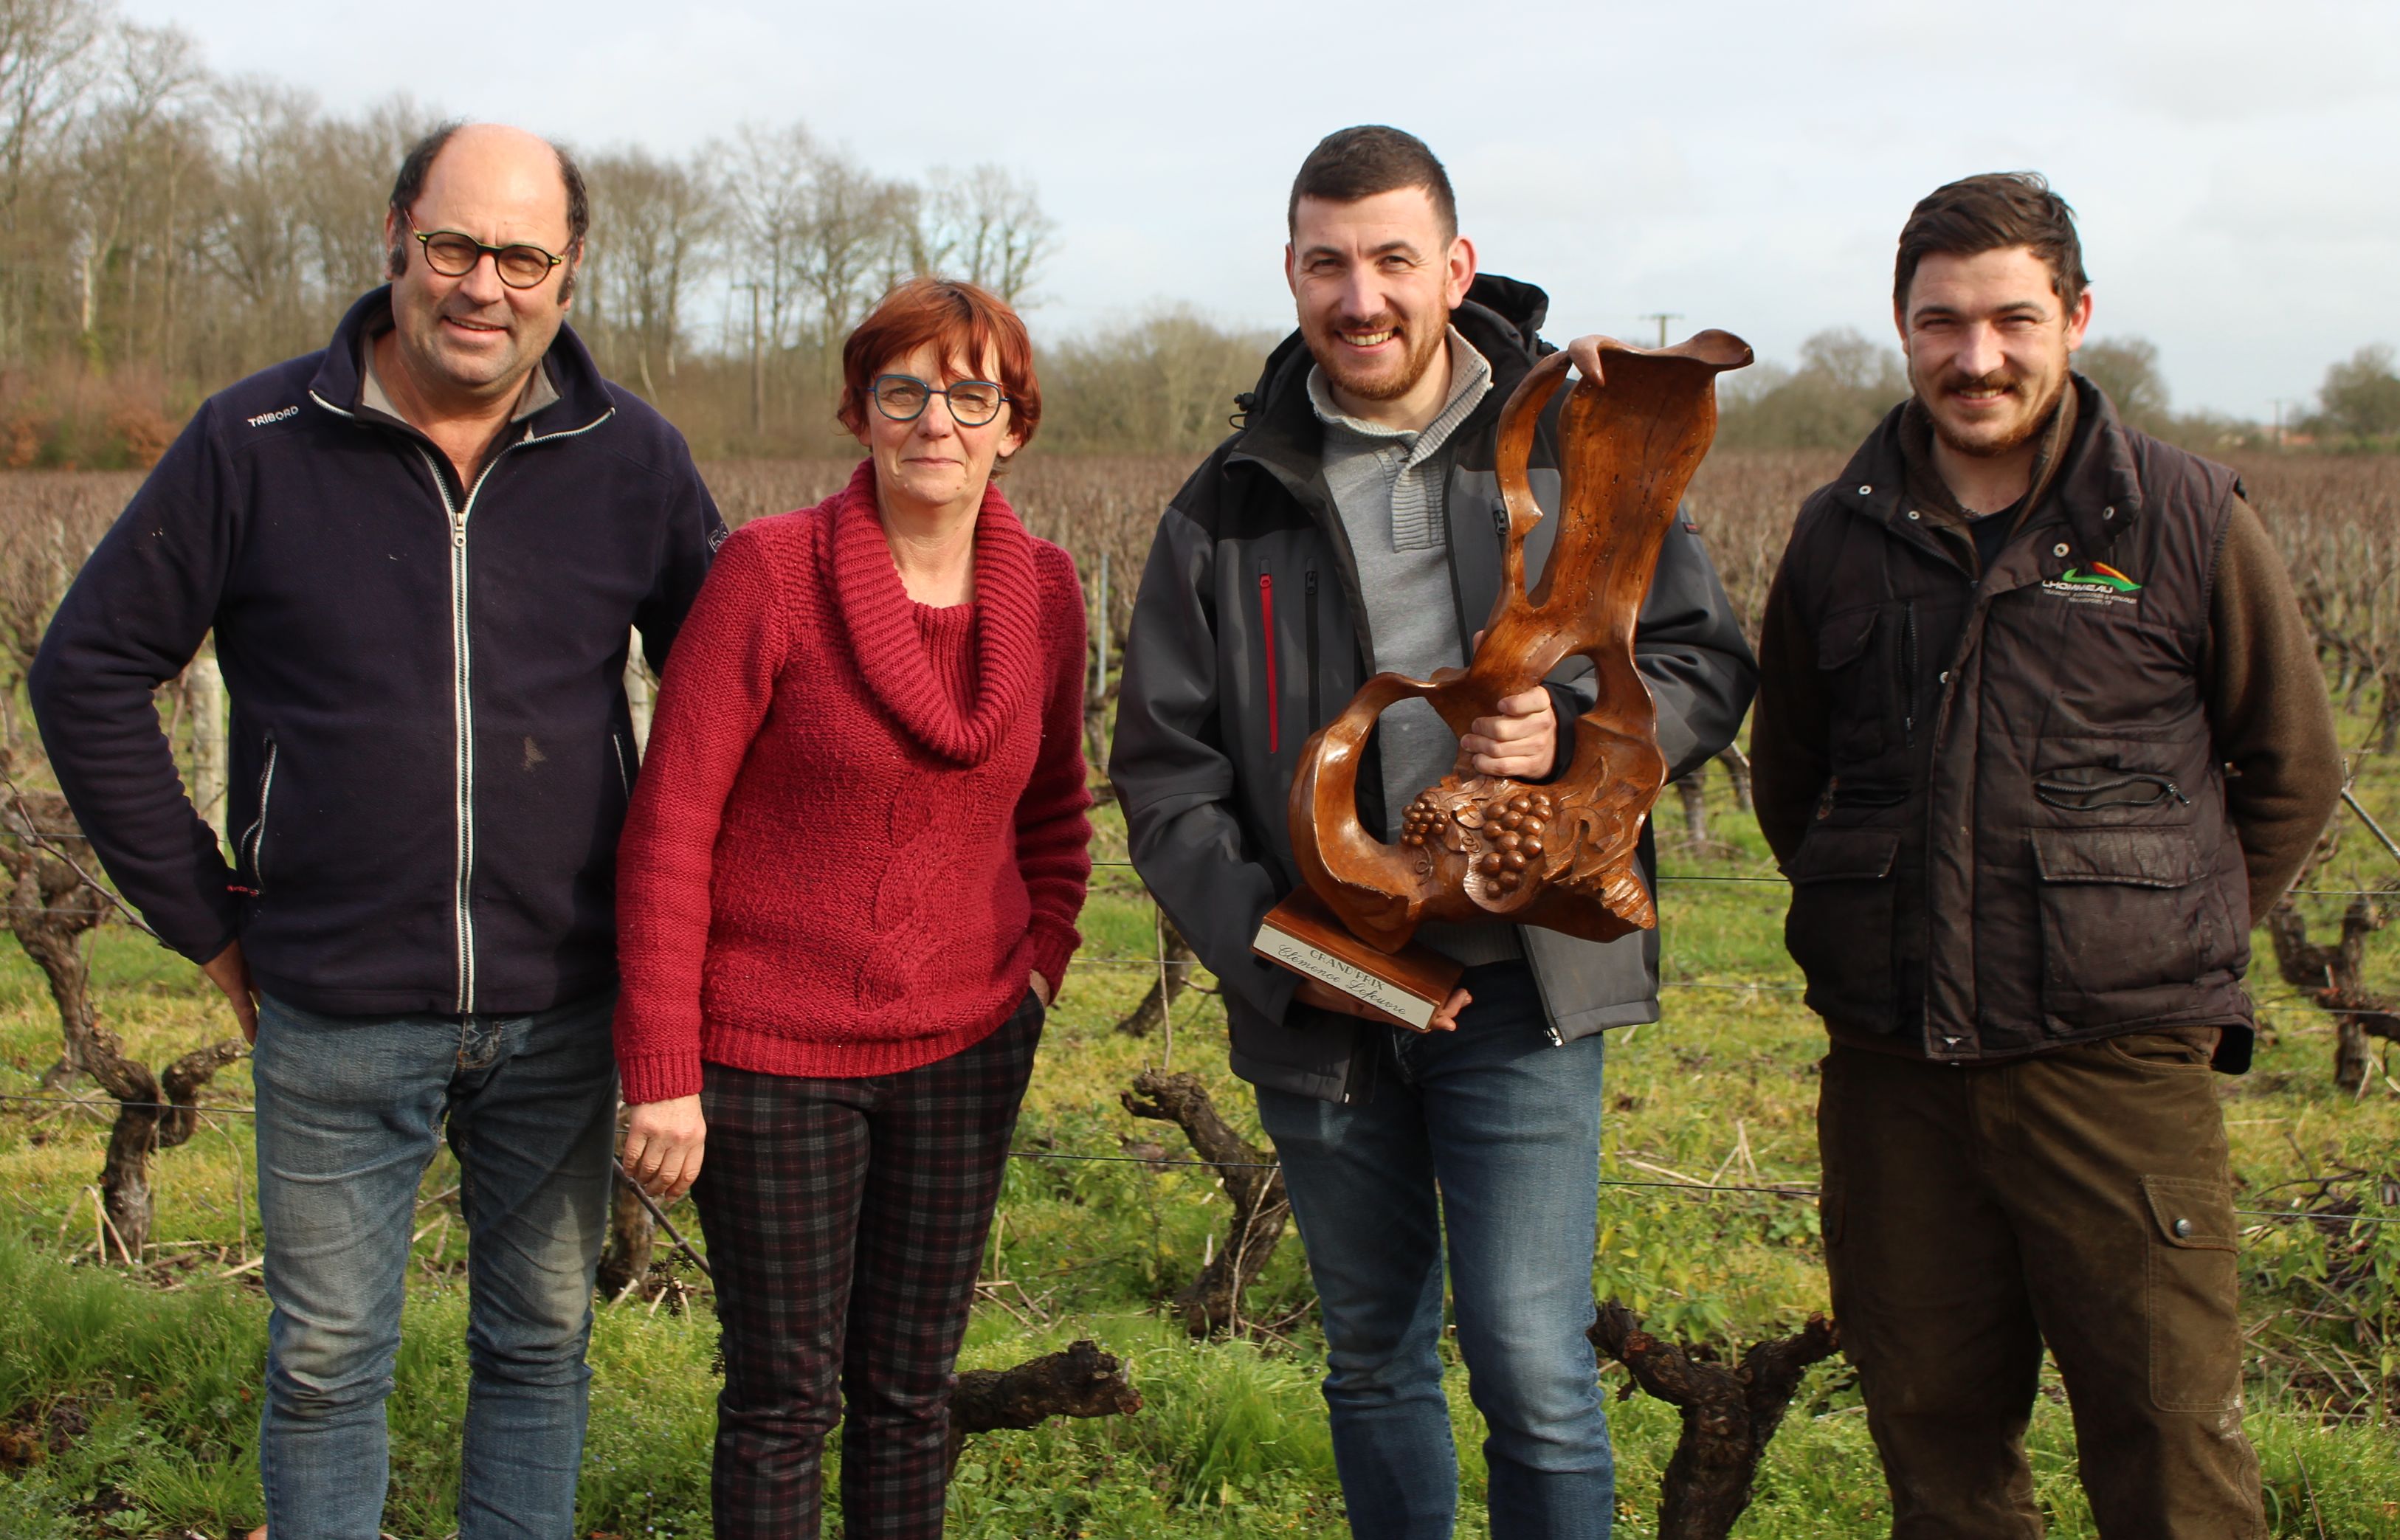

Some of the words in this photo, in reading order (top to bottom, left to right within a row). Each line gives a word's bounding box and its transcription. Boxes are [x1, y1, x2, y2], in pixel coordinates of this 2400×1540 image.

[247, 406, 299, 427] TRIBORD
[1278, 945, 1341, 983] Clémence
[1345, 980, 1406, 1015] Lefeuvre
[1310, 950, 1354, 975] GRAND
[1355, 972, 1385, 991] PRIX
